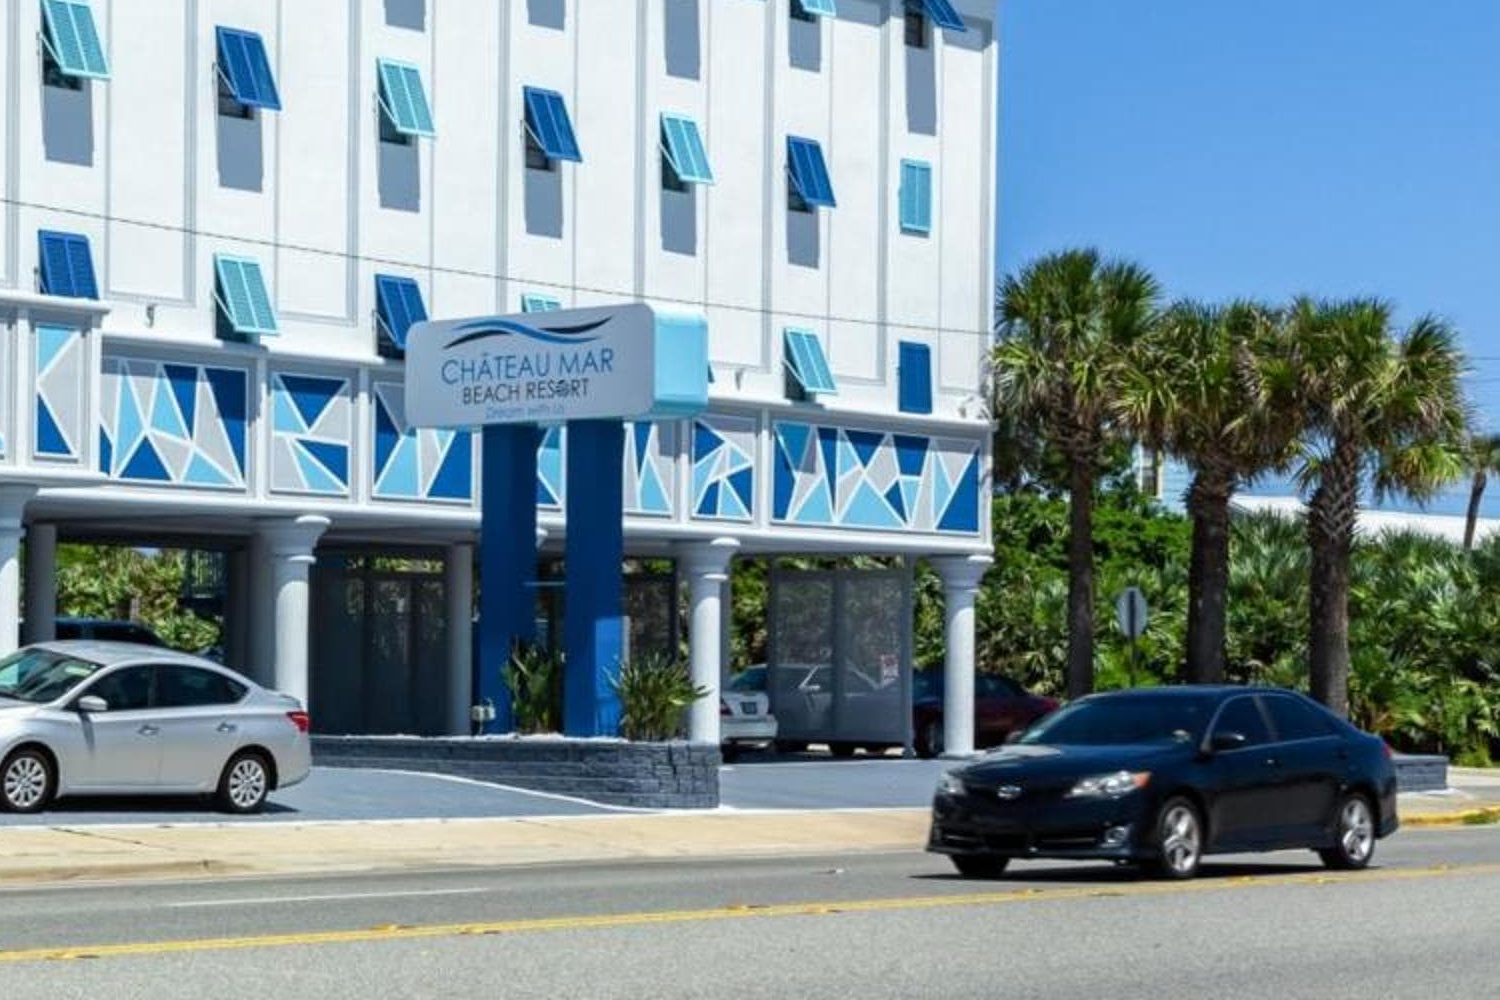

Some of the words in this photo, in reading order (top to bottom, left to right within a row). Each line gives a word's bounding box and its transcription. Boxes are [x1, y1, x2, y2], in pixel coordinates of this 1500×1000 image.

[441, 352, 550, 385] CHÂTEAU
[558, 348, 613, 374] MAR
[462, 383, 520, 405] BEACH
[526, 377, 590, 400] RESORT
